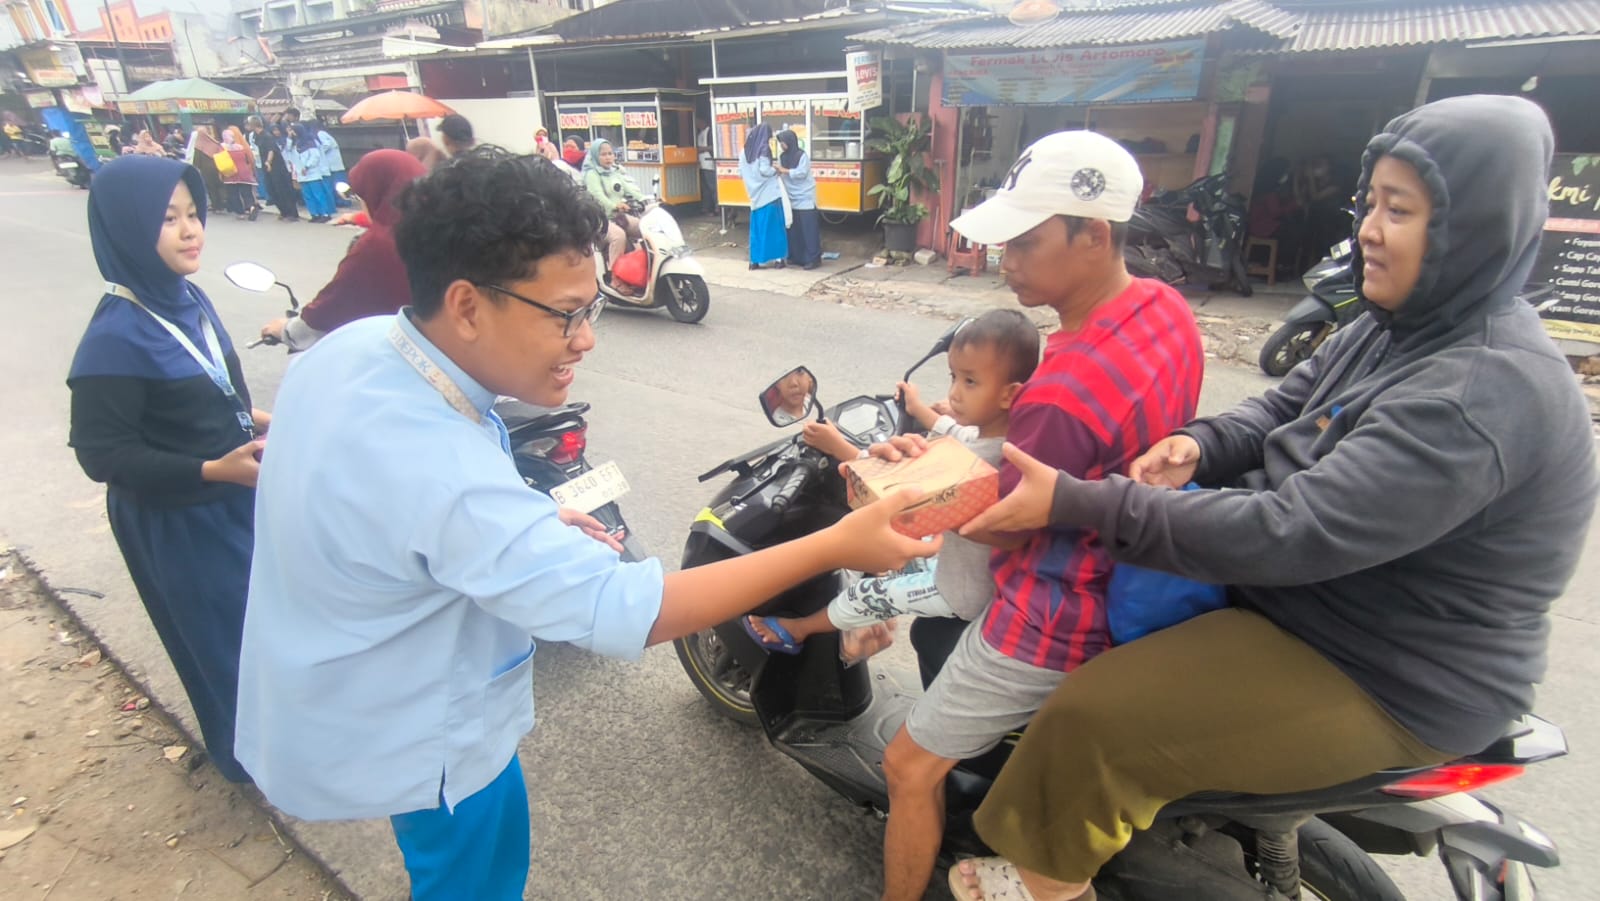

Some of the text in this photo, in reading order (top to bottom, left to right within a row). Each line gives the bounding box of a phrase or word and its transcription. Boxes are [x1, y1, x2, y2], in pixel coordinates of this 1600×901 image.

[1031, 51, 1073, 65] Lis
[560, 114, 589, 127] DONUTS
[555, 491, 566, 505] B
